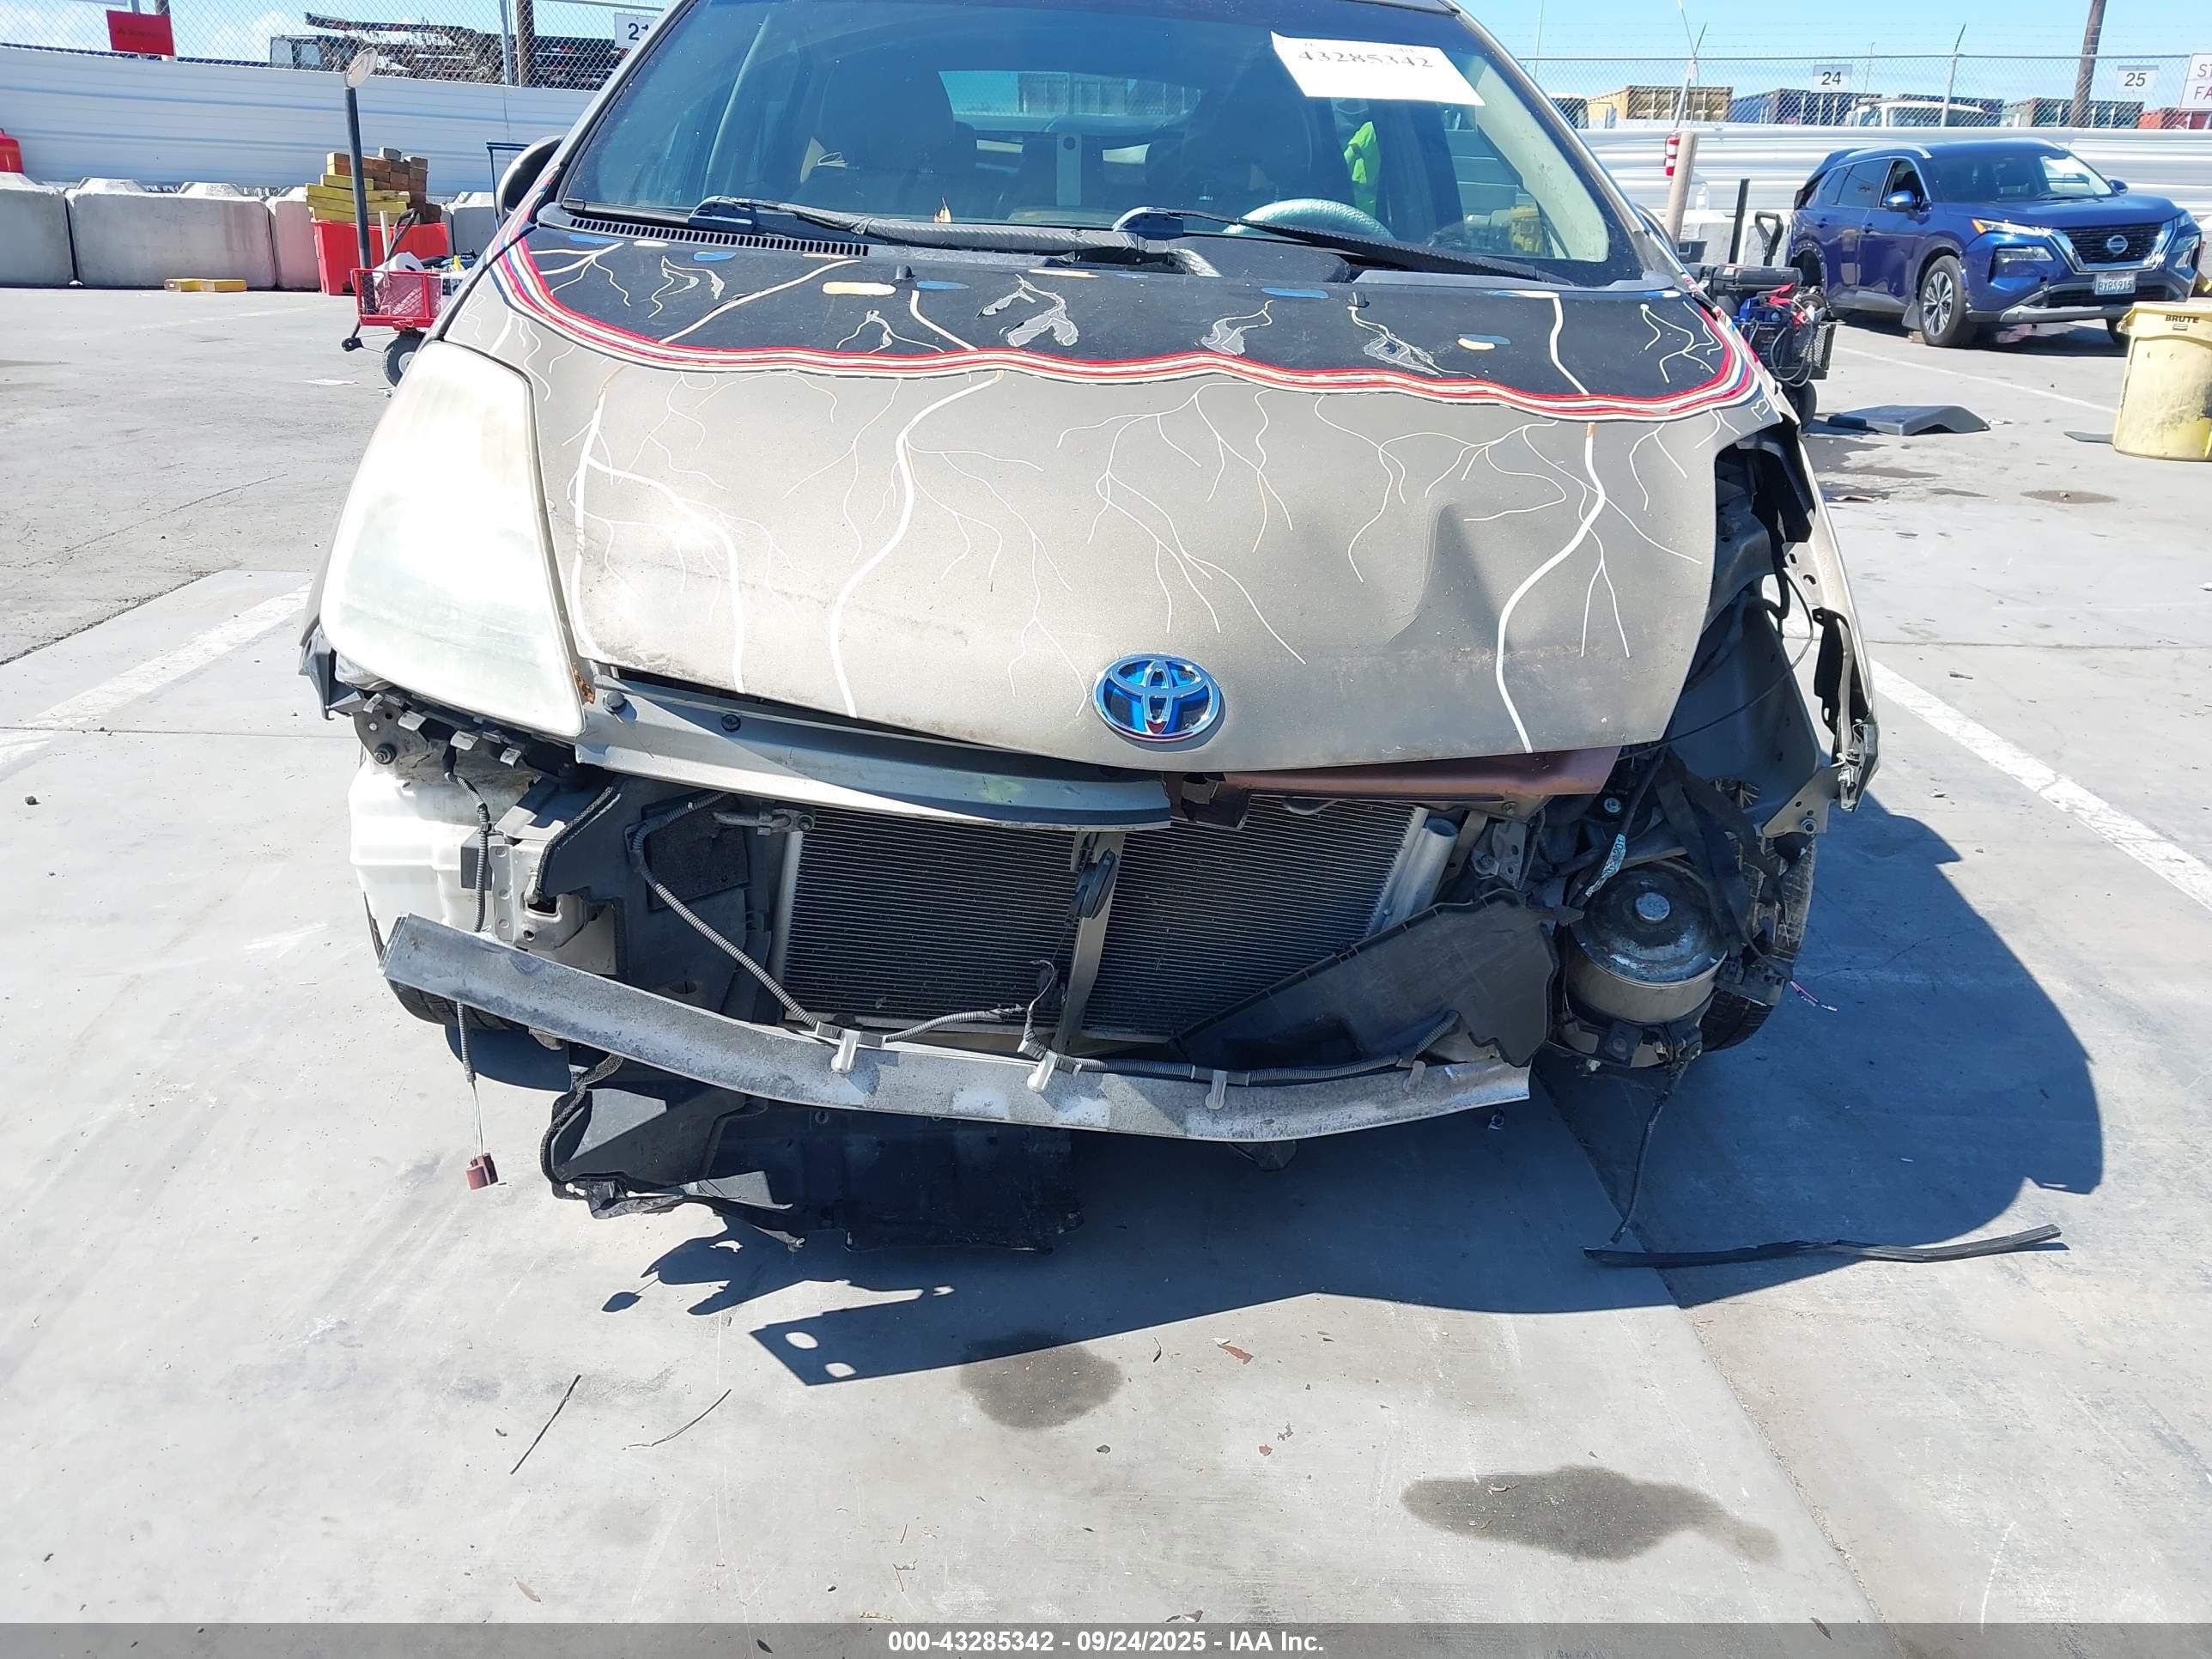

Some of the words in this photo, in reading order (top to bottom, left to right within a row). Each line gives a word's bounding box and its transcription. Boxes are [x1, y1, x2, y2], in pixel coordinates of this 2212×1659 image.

[1820, 71, 1842, 86] 24
[2124, 72, 2147, 88] 25
[2165, 314, 2200, 324] BRUTE
